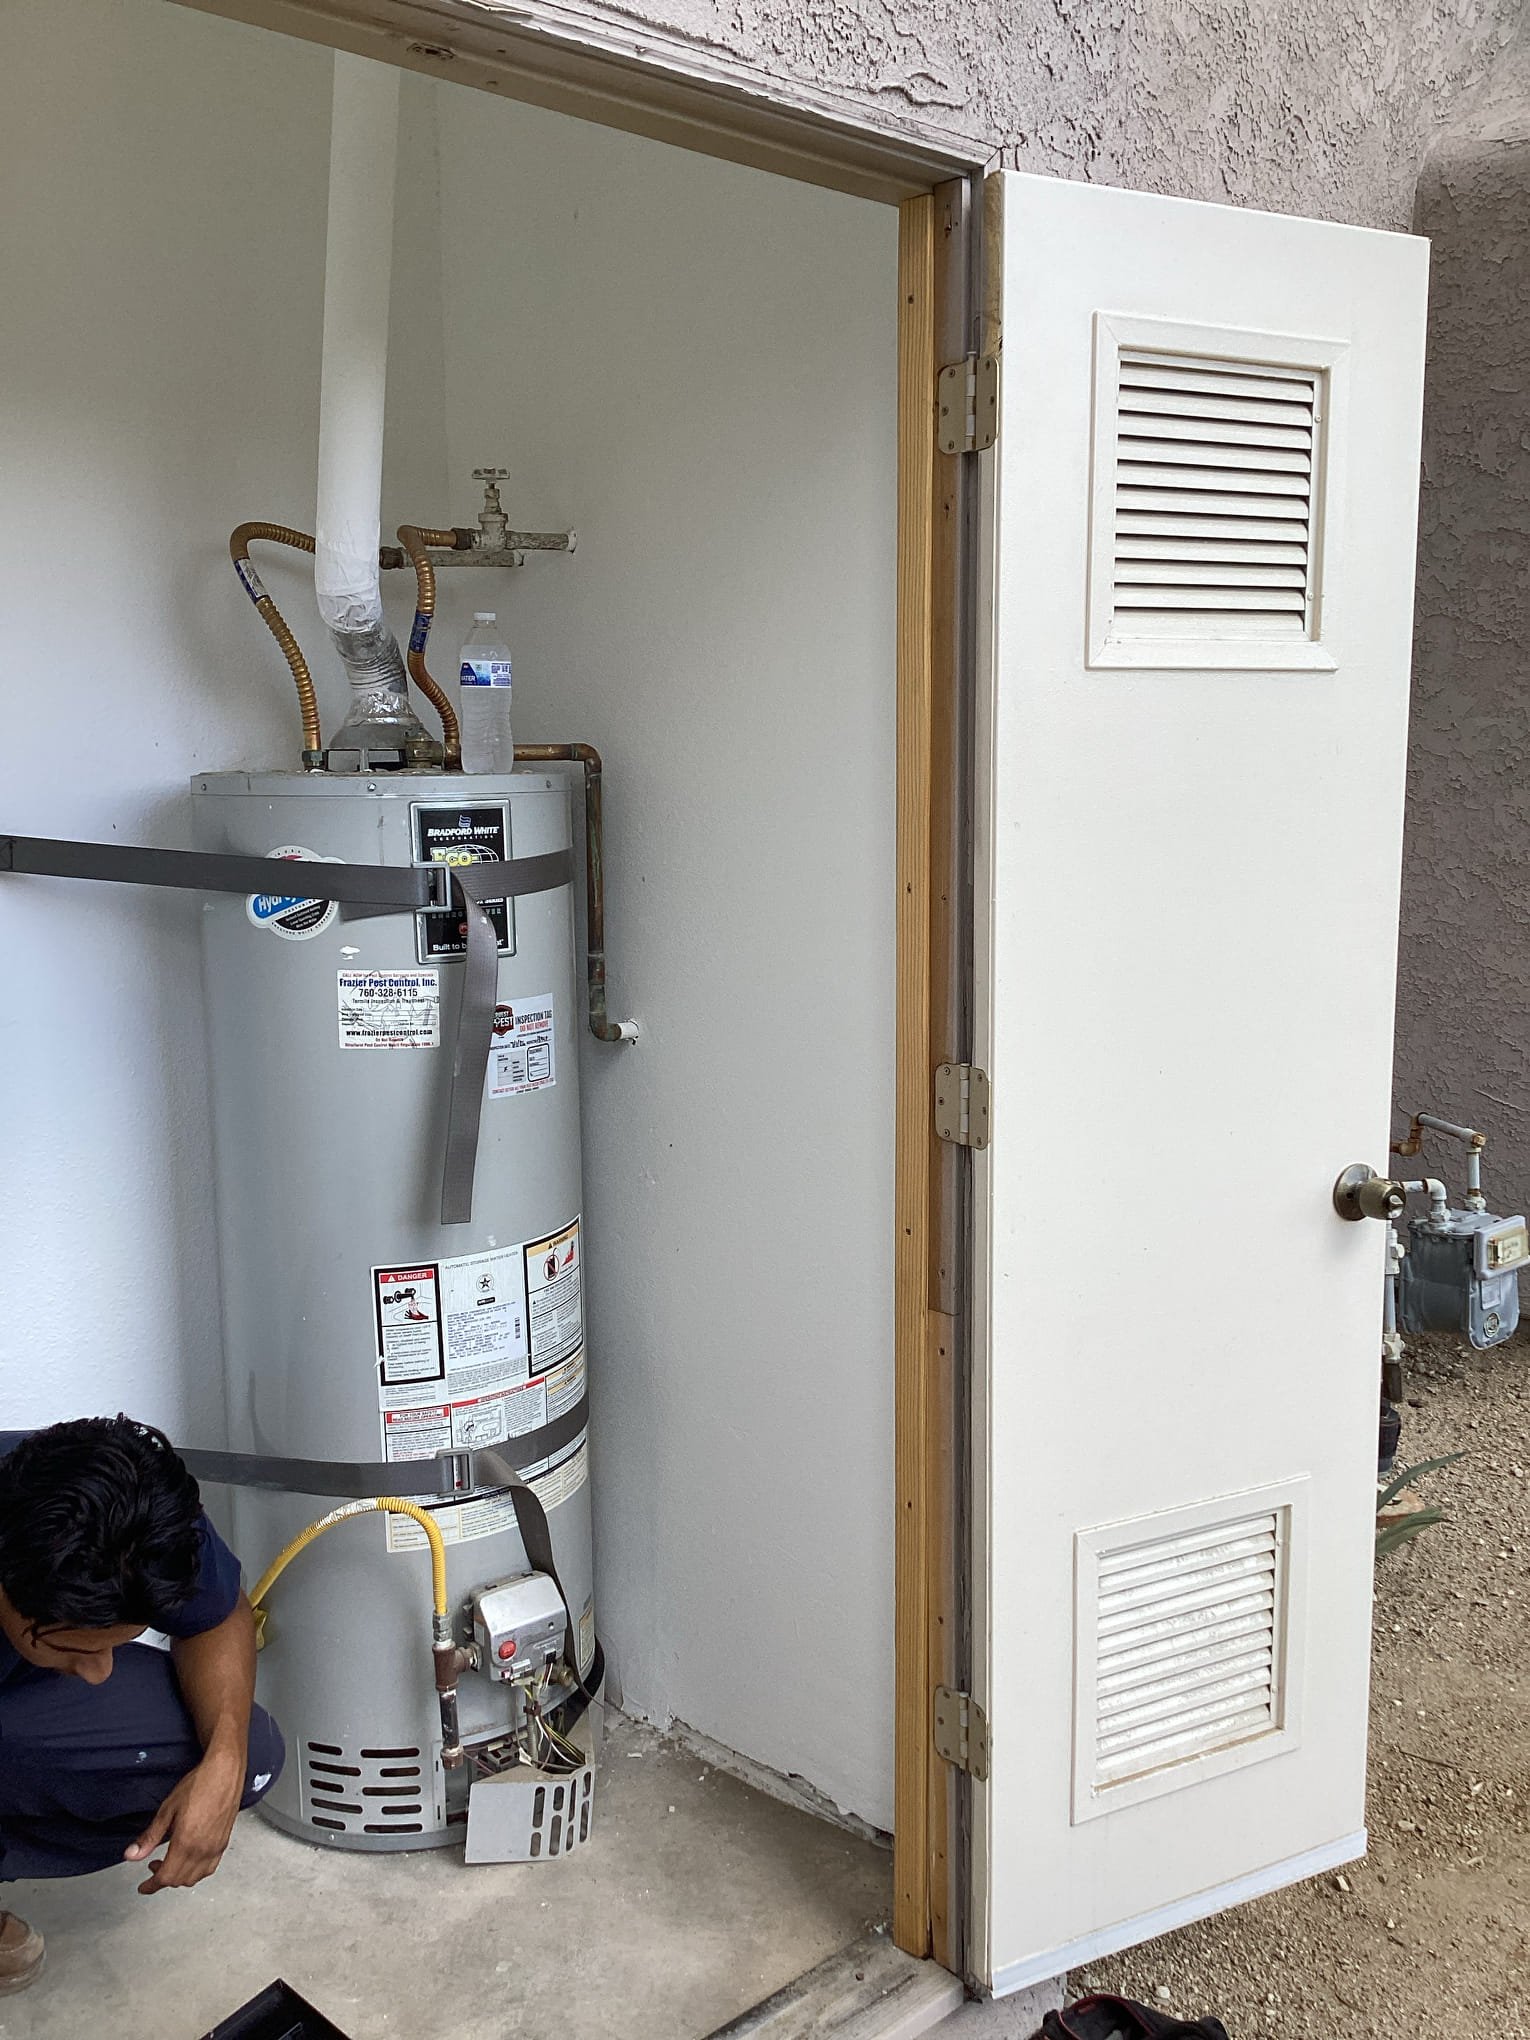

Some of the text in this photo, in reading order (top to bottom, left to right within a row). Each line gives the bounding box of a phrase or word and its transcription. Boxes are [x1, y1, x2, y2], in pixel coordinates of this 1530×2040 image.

[427, 826, 498, 837] BRADFORD WHITE
[432, 943, 451, 951] Built
[339, 978, 438, 988] Frazier Pest Control, Inc.
[359, 988, 418, 997] 760-328-6115
[515, 1012, 544, 1025] INSPECTION
[544, 1009, 553, 1019] TAG
[493, 1017, 513, 1028] PEST
[346, 1029, 433, 1037] www.frazierpestcontrol.com
[397, 1272, 428, 1281] DANGER
